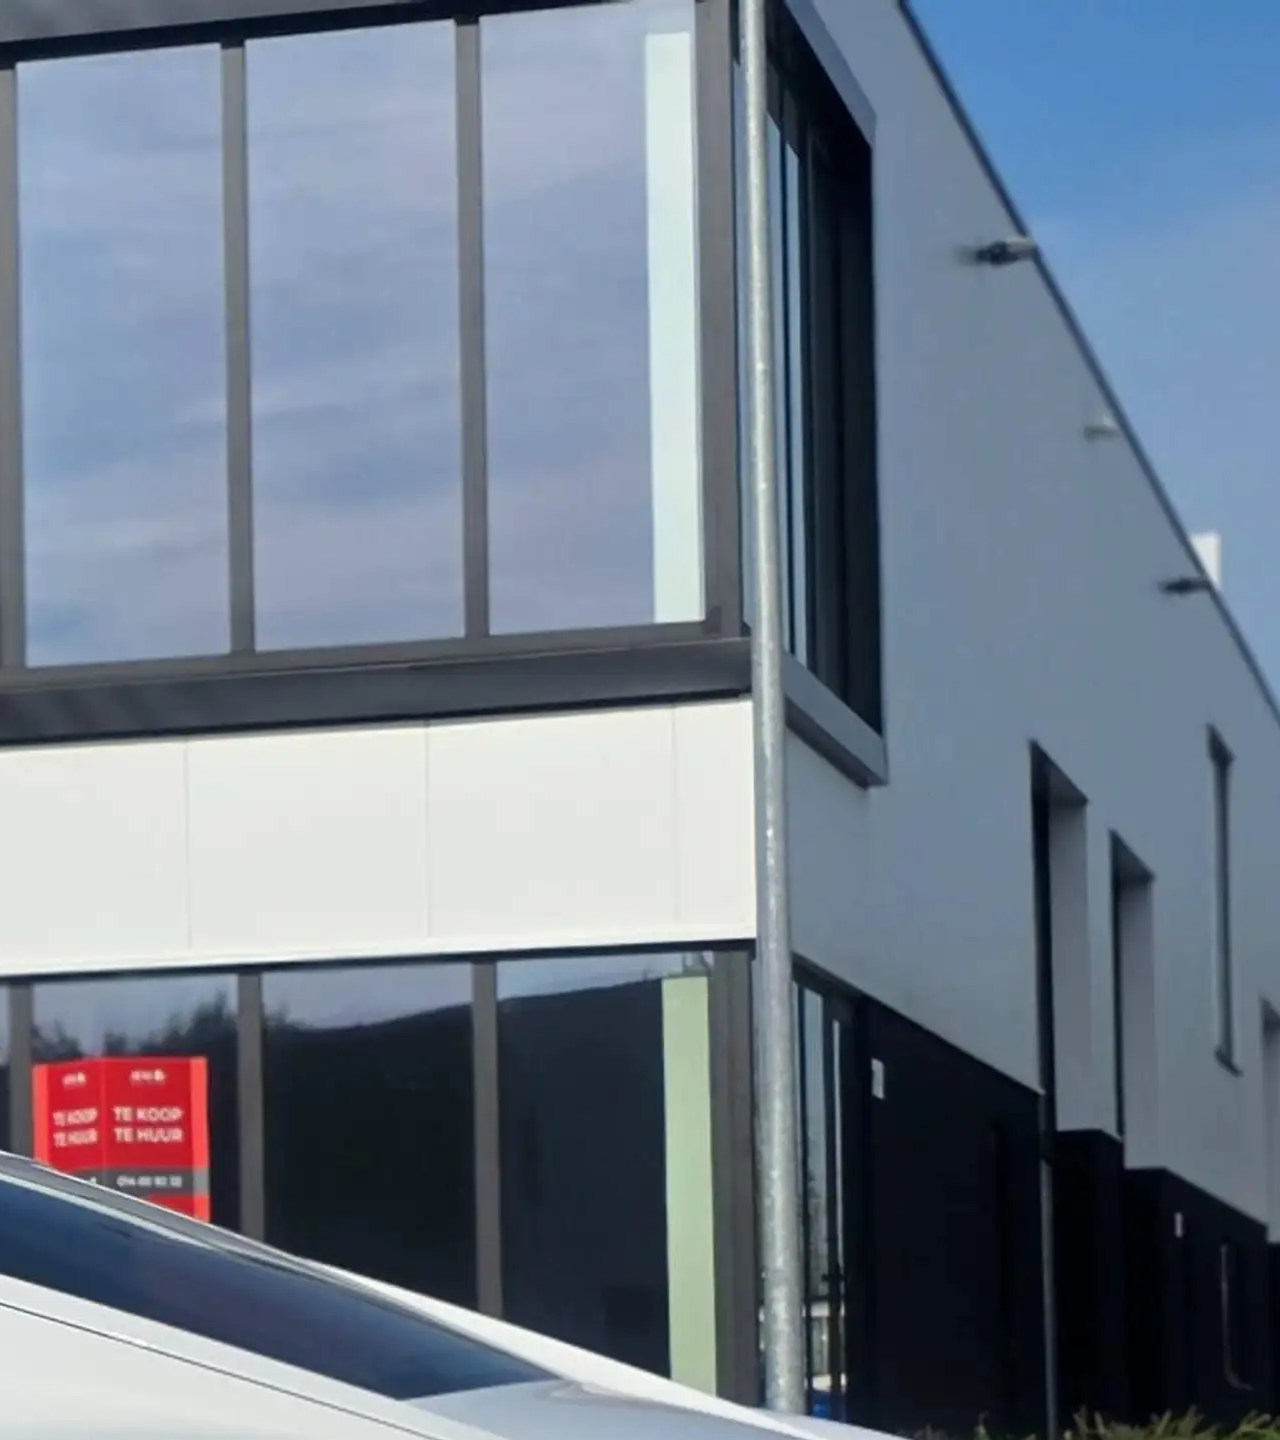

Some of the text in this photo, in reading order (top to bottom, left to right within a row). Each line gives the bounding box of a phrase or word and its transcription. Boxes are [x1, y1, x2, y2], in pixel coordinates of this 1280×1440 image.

[113, 1106, 183, 1122] TE KOOP
[113, 1127, 183, 1143] TE HUUR
